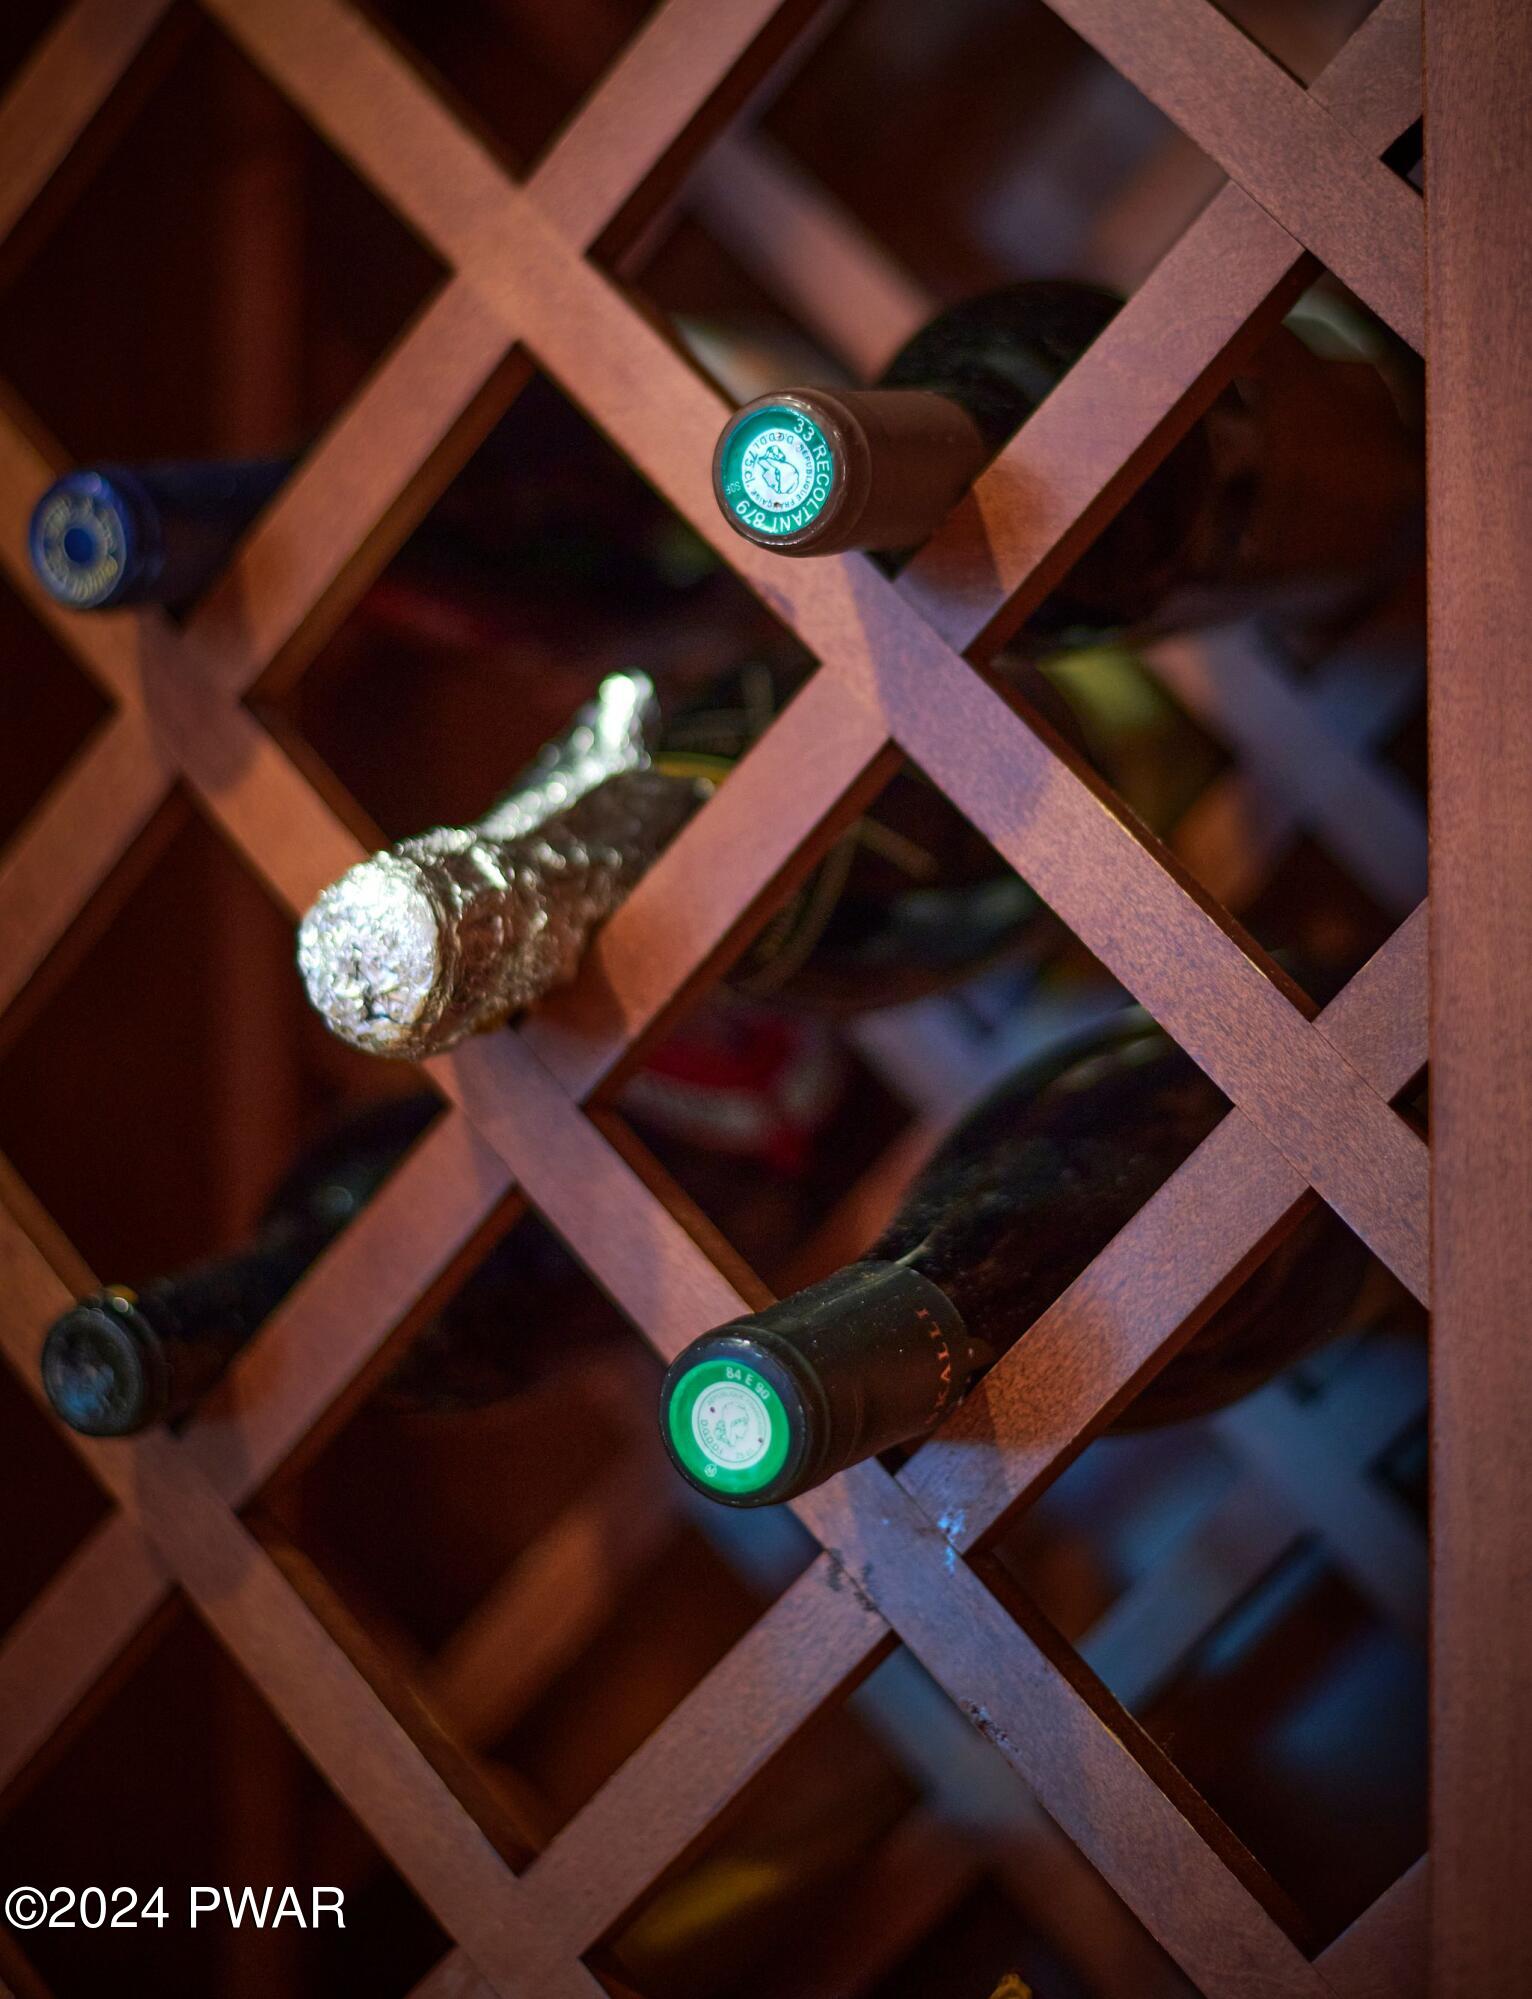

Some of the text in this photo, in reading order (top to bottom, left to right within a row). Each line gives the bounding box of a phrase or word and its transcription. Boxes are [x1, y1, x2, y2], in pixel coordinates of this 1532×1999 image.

[735, 417, 830, 533] 33 RECOLTANT 879
